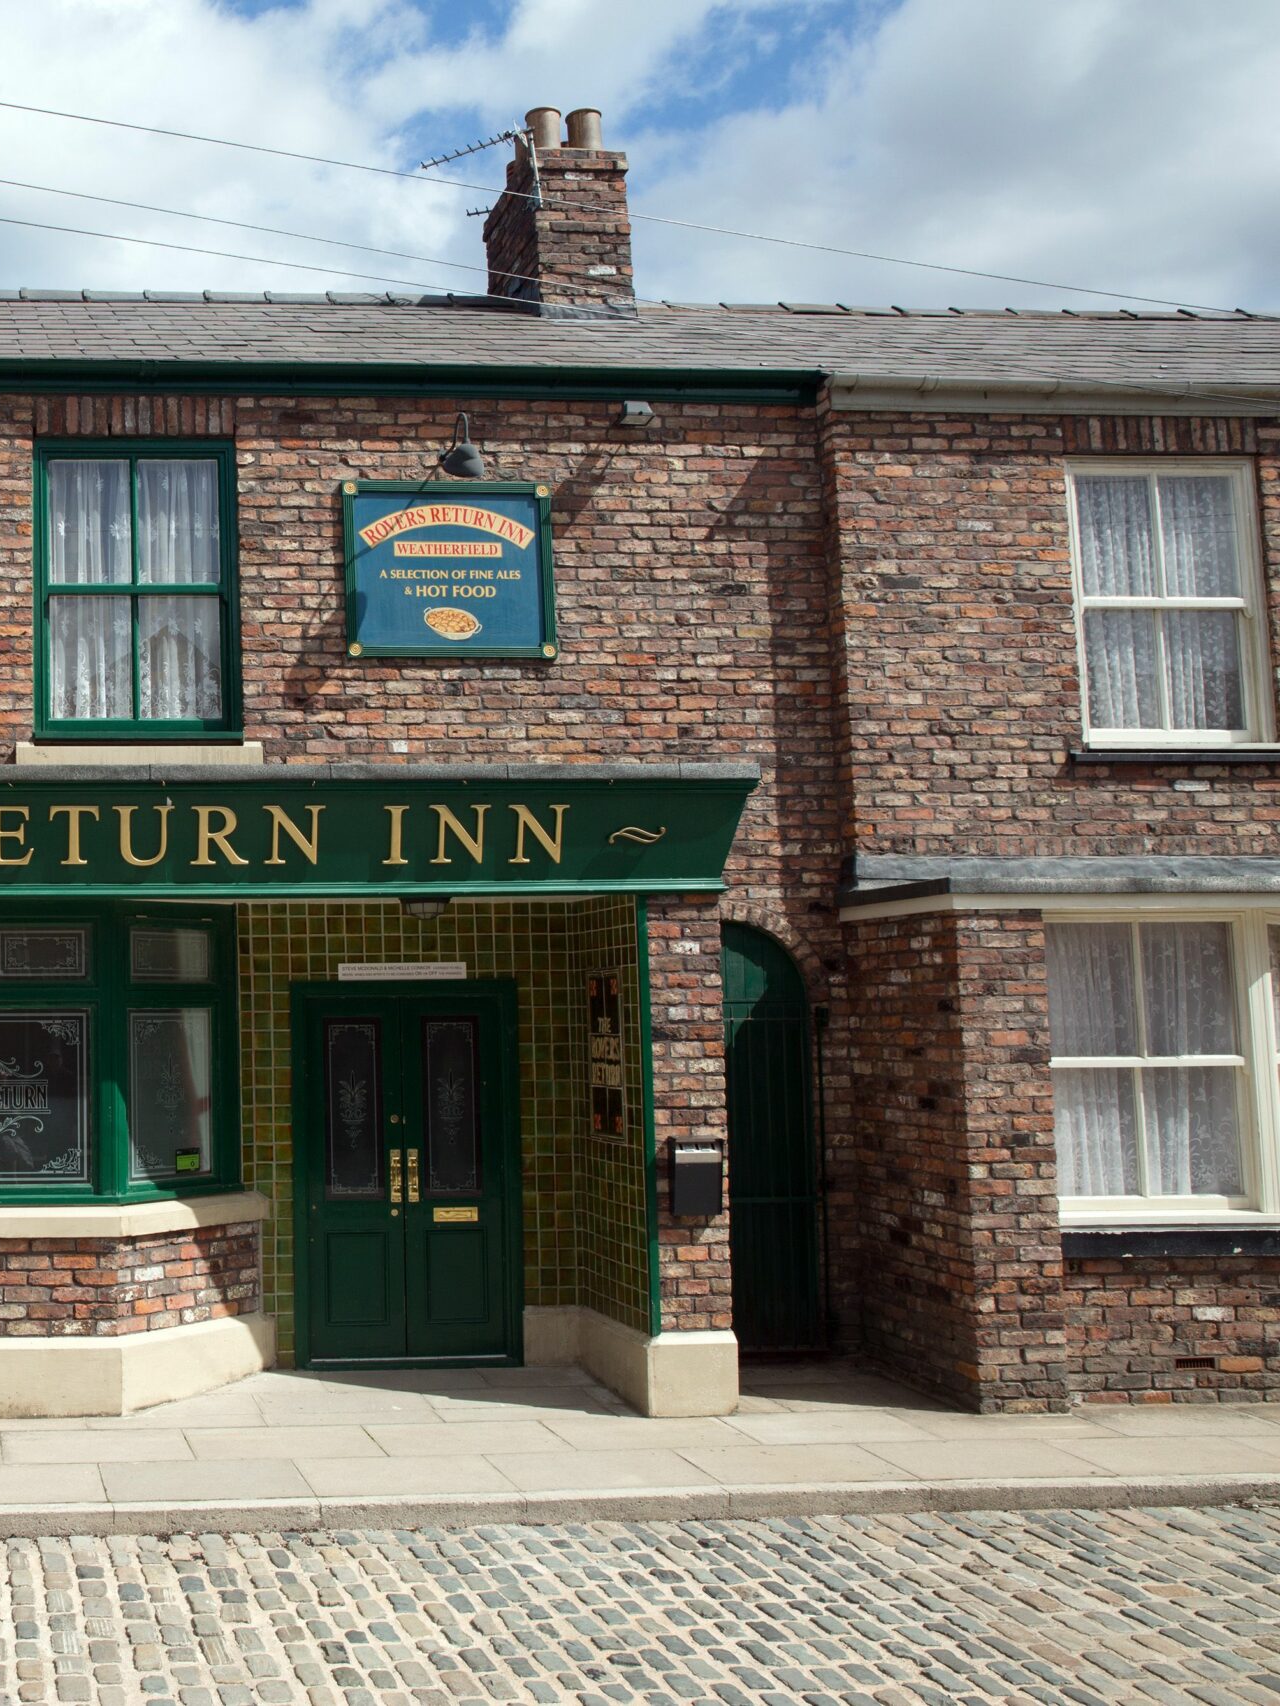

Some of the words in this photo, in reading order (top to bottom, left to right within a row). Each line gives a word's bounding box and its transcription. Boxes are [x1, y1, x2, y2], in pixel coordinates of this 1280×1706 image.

[364, 508, 426, 545] ROVERS
[430, 507, 497, 530] RETURN
[497, 518, 529, 545] INN
[397, 543, 498, 556] WEATHERFIELD
[379, 569, 388, 579] A
[390, 569, 449, 579] SELECTION
[451, 570, 467, 580] OF
[470, 570, 494, 580] FINE
[496, 570, 521, 580] ALES
[404, 586, 413, 596] &
[416, 585, 449, 597] HOT
[453, 585, 497, 598] FOOD
[381, 804, 571, 865] INN
[597, 1016, 612, 1033] THE
[591, 1035, 621, 1061] ROVERS
[592, 1062, 622, 1087] RETURN
